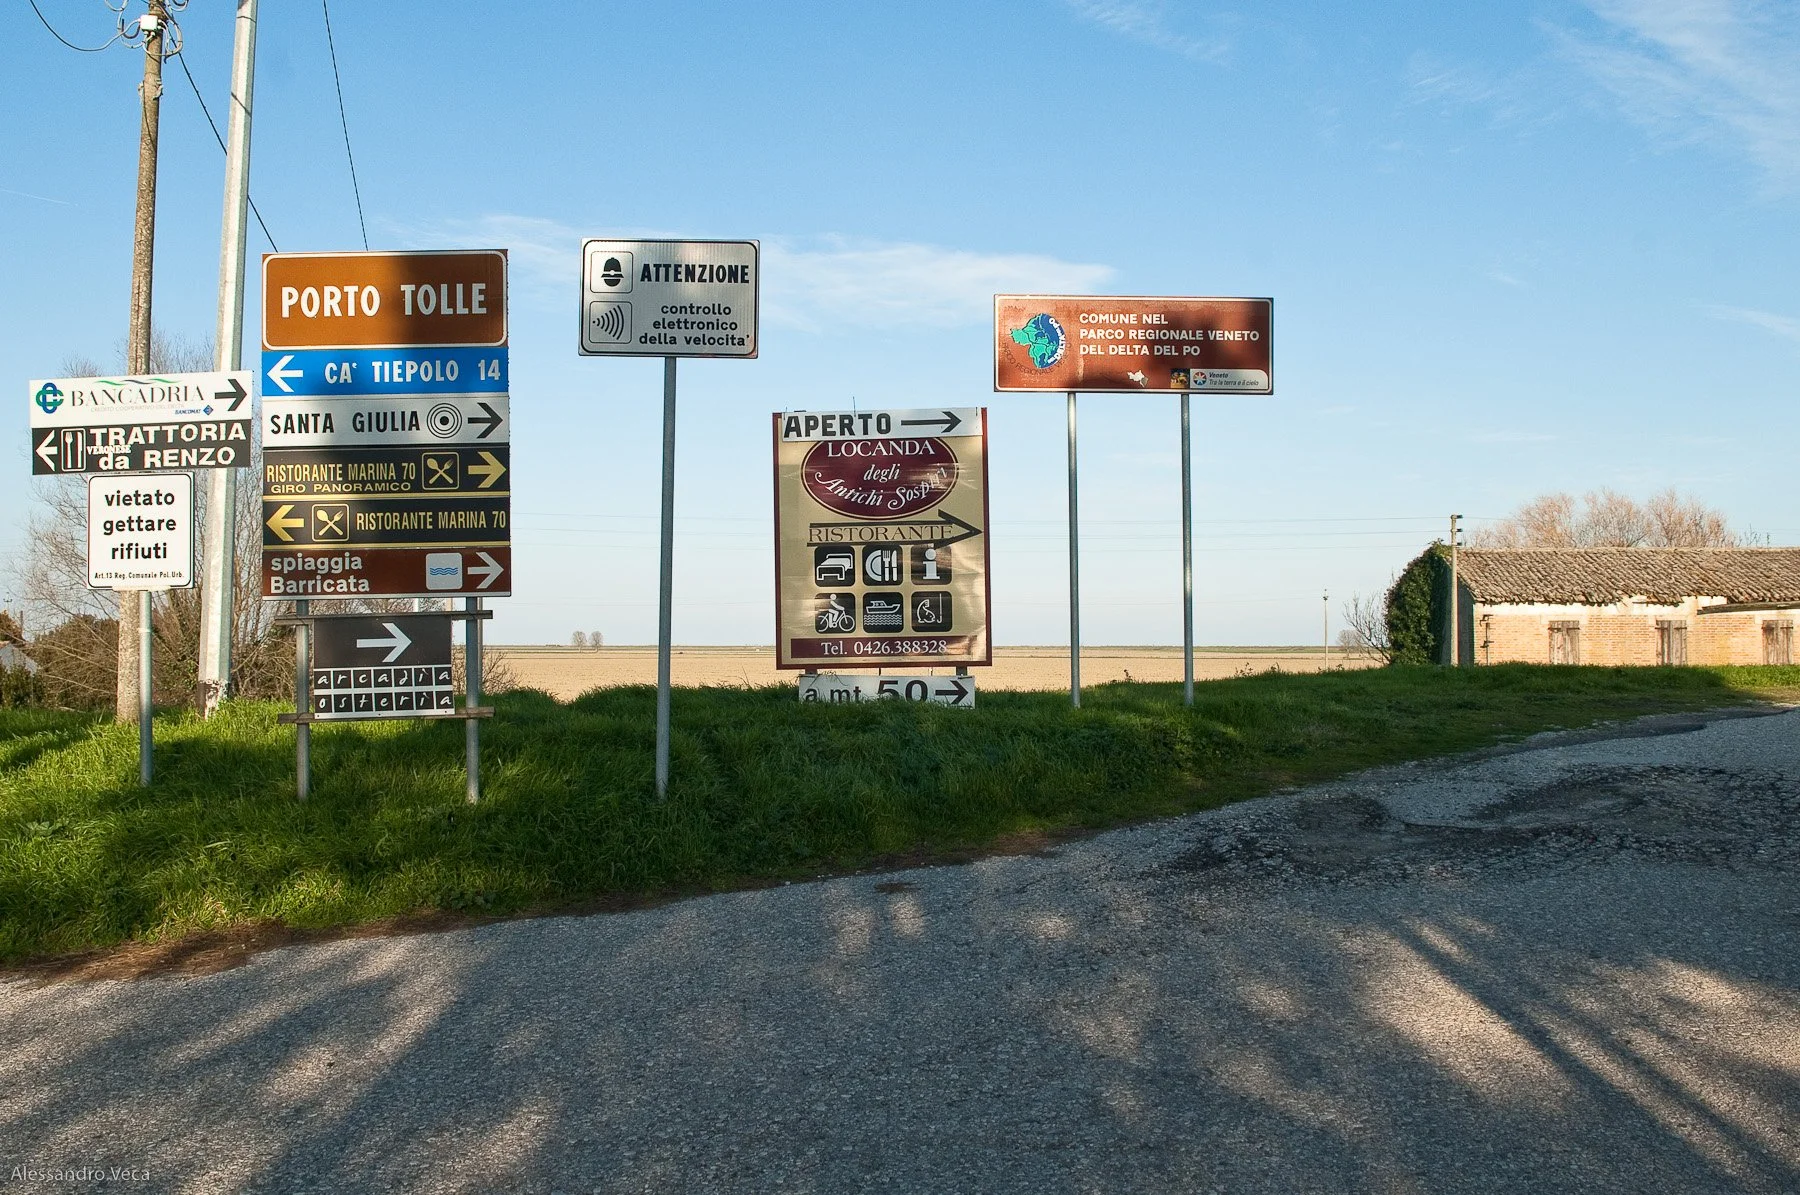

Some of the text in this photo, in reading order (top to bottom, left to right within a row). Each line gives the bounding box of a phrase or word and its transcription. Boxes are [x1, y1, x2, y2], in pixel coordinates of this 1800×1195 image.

[640, 263, 750, 284] ATTENZIONE
[281, 283, 487, 318] PORTO TOLLE
[661, 303, 732, 316] controllo
[652, 318, 738, 331] elettronico
[1079, 313, 1168, 325] COMUNE NEL
[639, 333, 750, 347] della velocita'
[1079, 329, 1260, 341] PARCO REGIONALE VENETO
[1079, 344, 1201, 356] DEL DELTA DEL PO
[372, 360, 459, 383] TIEPOLO
[478, 359, 501, 381] 14
[71, 385, 205, 407] BANCADRIA
[270, 410, 421, 434] SANTA GIULIA
[783, 413, 892, 438] APERTO
[89, 422, 247, 446] TRATTORIA
[86, 444, 132, 455] VERONESE
[827, 440, 935, 457] LOCANDA
[98, 447, 236, 471] da RENZO
[266, 462, 416, 483] RISTORANTE MARINA 70
[863, 463, 901, 483] degli
[270, 482, 412, 494] GIRO PANORAMICO
[814, 471, 883, 506] Antichi
[104, 489, 175, 507] vietato
[103, 515, 177, 535] gettare
[356, 510, 507, 531] RISTORANTE MARINA 70
[809, 525, 953, 542] RISTORANTE
[111, 543, 168, 560] rifiuti
[270, 552, 363, 574] spiaggia
[270, 575, 370, 594] Barricata
[820, 639, 948, 656] Tel. 0426.388328
[317, 667, 451, 686] arcadia
[805, 687, 818, 701] a
[877, 679, 928, 702] 50
[318, 692, 452, 709] osteria
